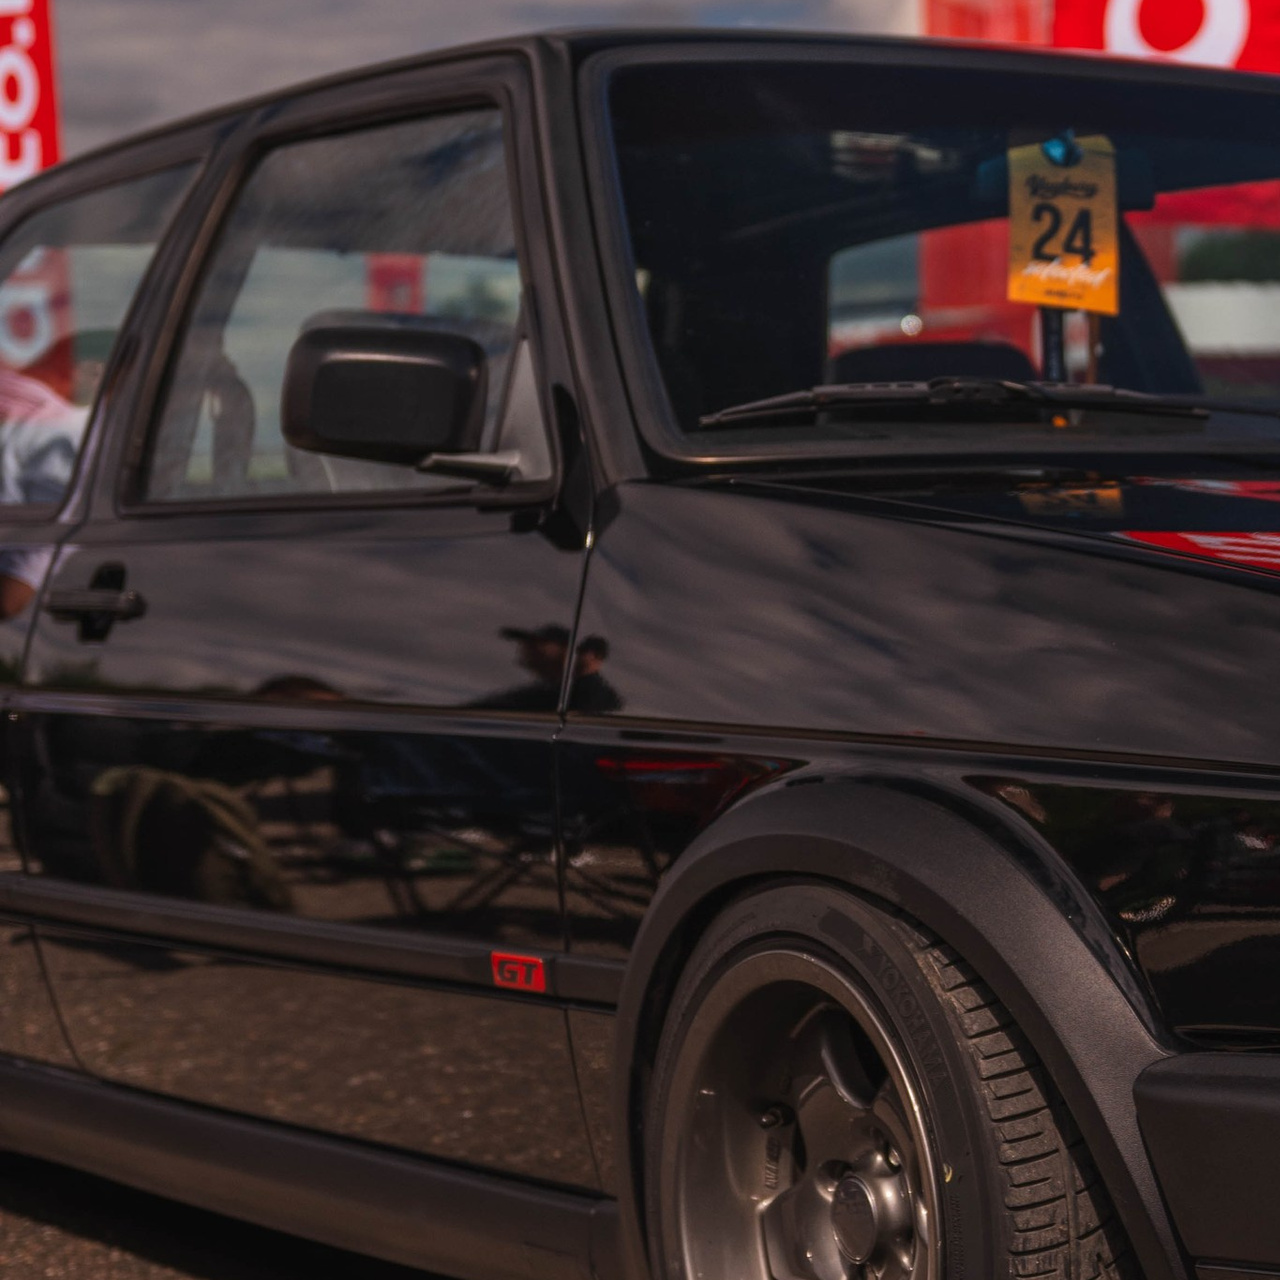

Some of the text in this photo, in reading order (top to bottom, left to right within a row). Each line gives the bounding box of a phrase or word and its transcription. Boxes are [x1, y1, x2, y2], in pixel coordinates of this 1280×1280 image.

[1032, 202, 1095, 265] 24
[498, 960, 538, 985] GT
[873, 948, 949, 1093] YOKOHAMA
